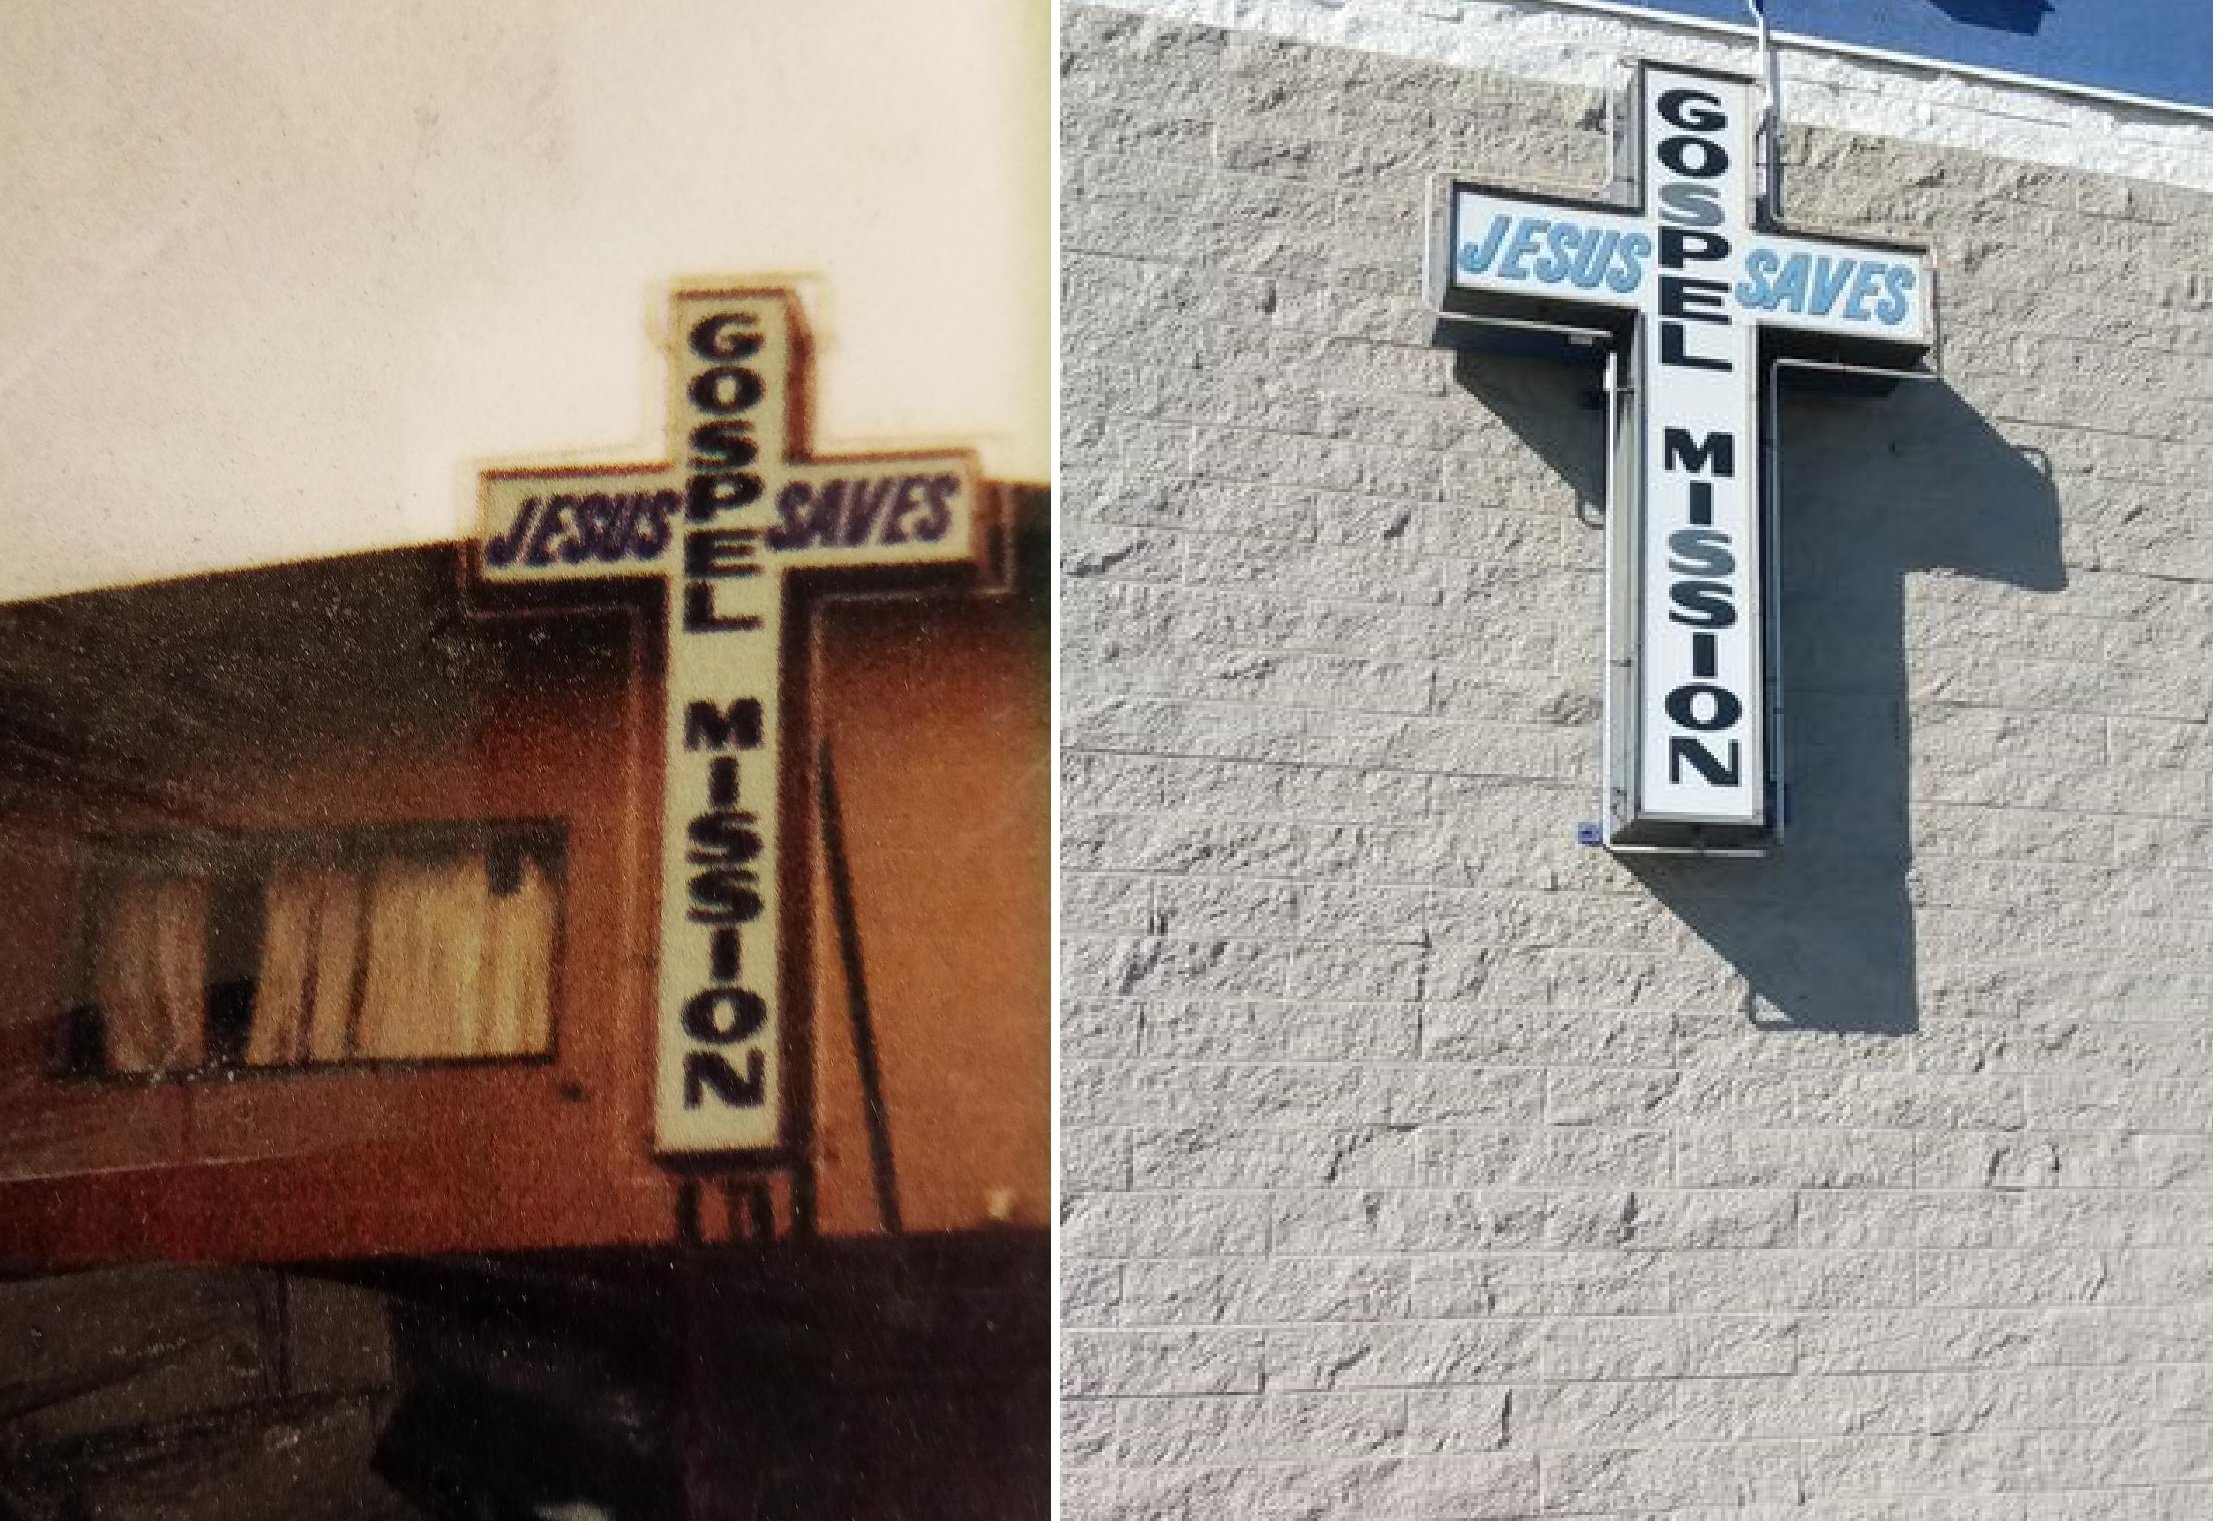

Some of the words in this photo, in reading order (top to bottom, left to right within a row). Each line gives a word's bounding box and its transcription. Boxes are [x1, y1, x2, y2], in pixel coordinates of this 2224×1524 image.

[1457, 213, 1652, 293] JESUS
[1735, 248, 1914, 326] SAVES
[1657, 89, 1733, 372] GOSPEL
[487, 490, 682, 566] JESUS
[765, 472, 959, 551] SAVES
[685, 313, 763, 633] GOSPEL
[1664, 427, 1742, 787] MISSION
[682, 698, 767, 1109] MISSION
